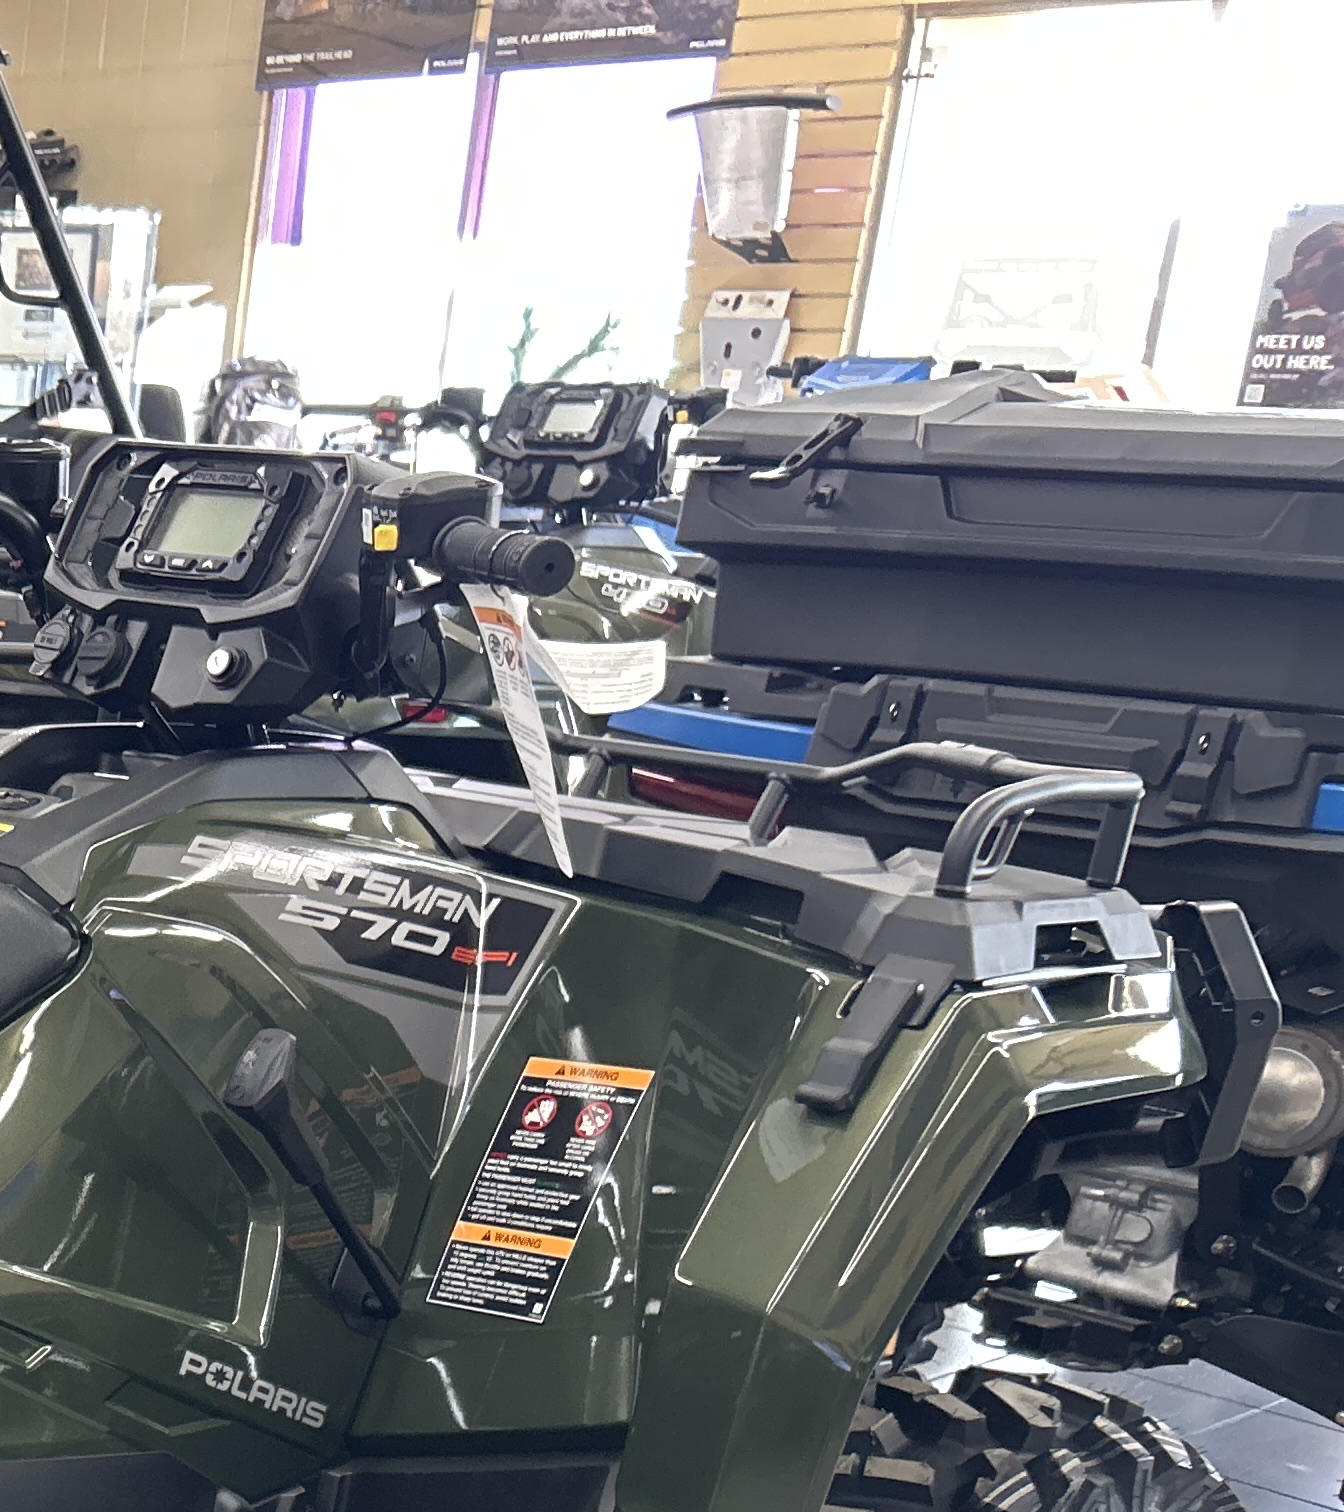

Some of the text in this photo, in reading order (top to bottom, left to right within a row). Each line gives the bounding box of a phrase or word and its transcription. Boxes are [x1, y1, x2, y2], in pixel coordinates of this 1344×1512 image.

[1255, 334, 1326, 350] MEET US
[1252, 353, 1334, 371] OUT HERE.
[180, 835, 501, 928] SPORTSMAN
[278, 894, 518, 967] 570 EFI
[569, 1065, 620, 1082] WARNING
[494, 1231, 543, 1249] WARNING
[178, 1350, 328, 1429] POLARIS
